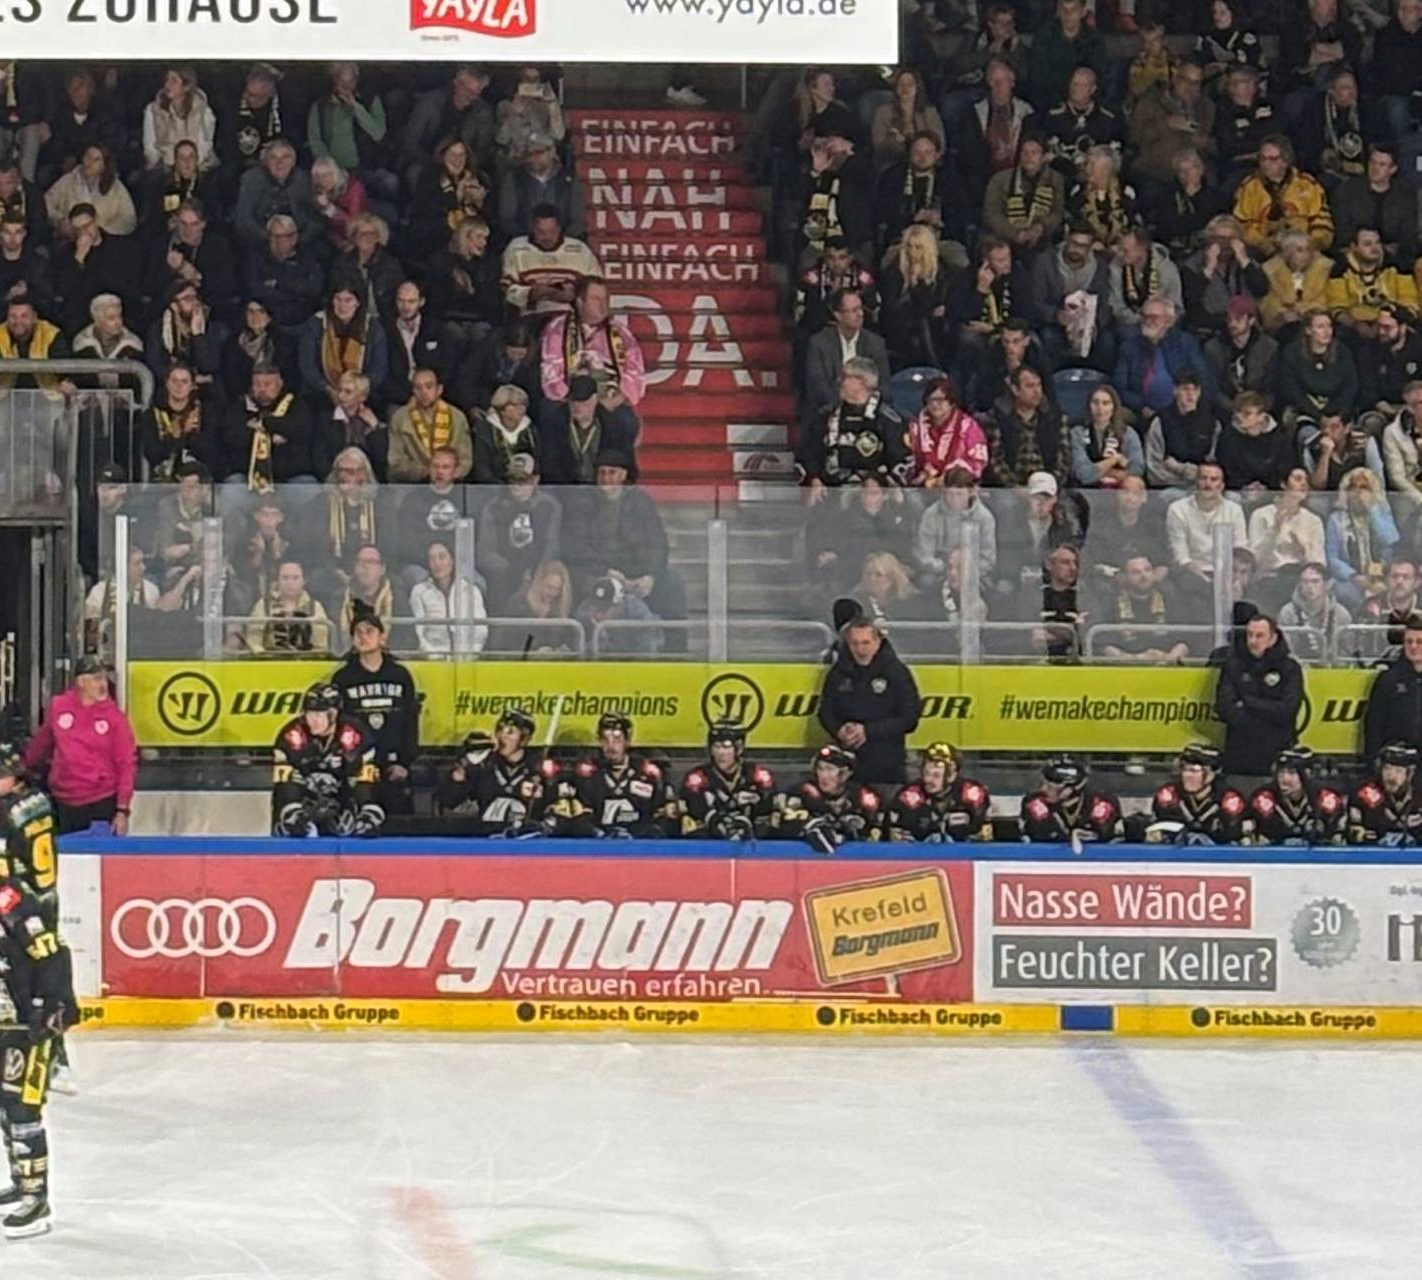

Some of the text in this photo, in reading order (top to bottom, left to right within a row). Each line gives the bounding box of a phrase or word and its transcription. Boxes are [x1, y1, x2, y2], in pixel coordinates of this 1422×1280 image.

[581, 119, 735, 154] EINFACH
[599, 244, 759, 281] EINFACH
[832, 892, 927, 928] Krefeld
[999, 883, 1247, 922] Nasse Wände?
[282, 878, 794, 993] Borgmann
[1310, 905, 1341, 936] 30
[831, 921, 939, 957] Borgmann
[999, 941, 1273, 983] Feuchter Keller?
[501, 972, 637, 995] Vertrauen
[239, 1004, 400, 1023] Fischbach Gruppe
[540, 1005, 699, 1025] Fischbach Gruppe
[839, 1008, 1003, 1027] Fischbach Gruppe
[1214, 1011, 1376, 1030] Fischbach Gruppe
